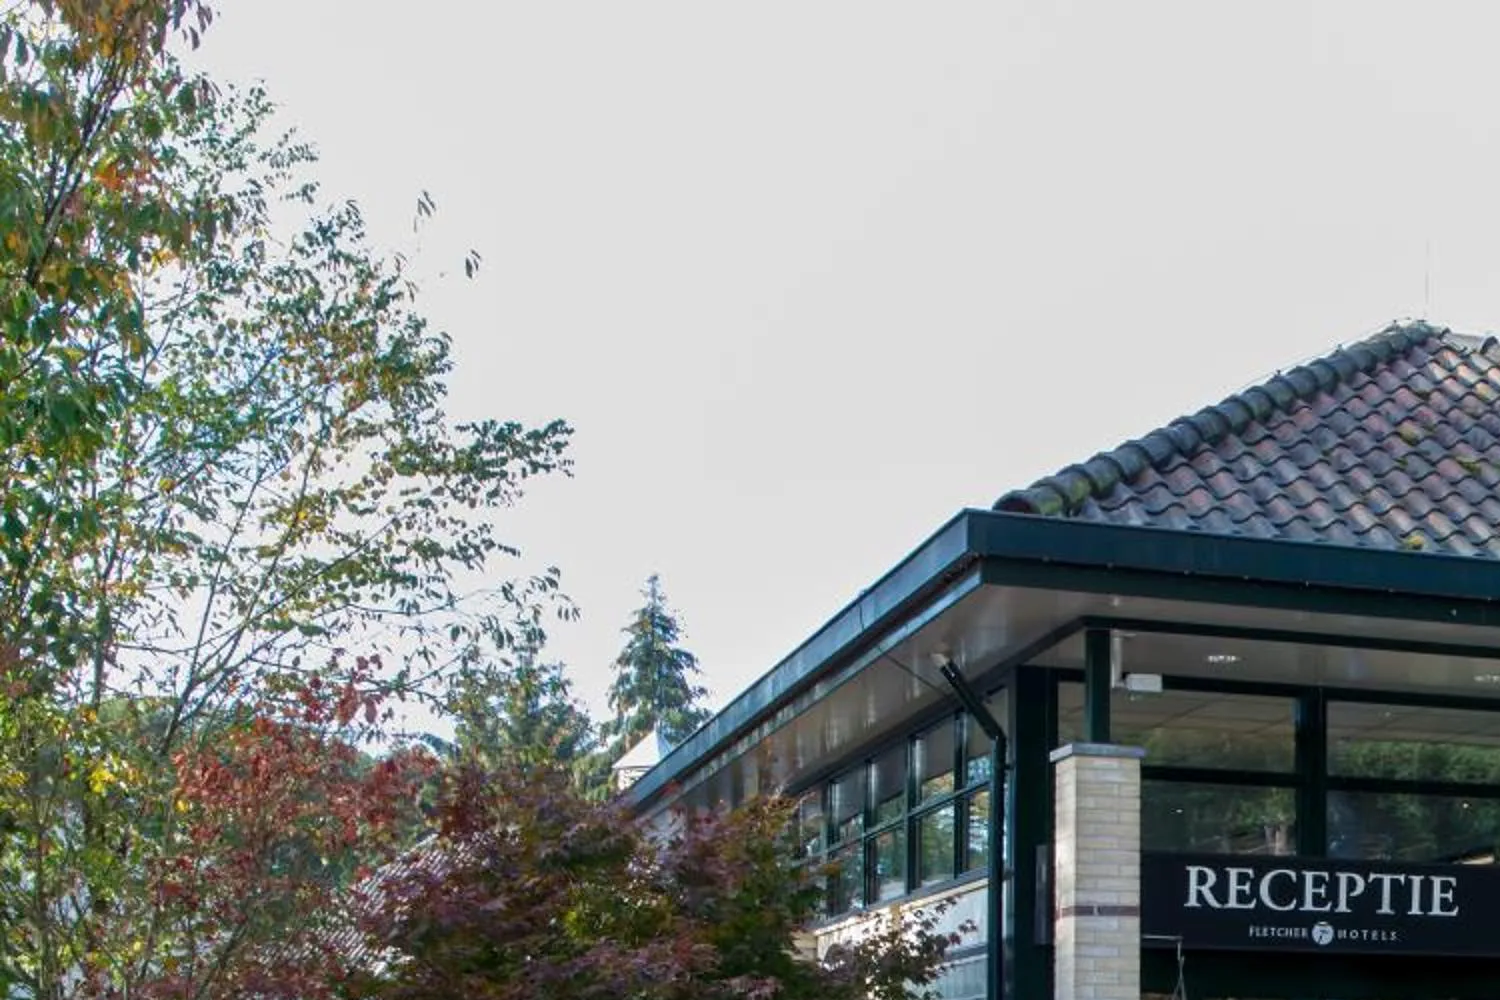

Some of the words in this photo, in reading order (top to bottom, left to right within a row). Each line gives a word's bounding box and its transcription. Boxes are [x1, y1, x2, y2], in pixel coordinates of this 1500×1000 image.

[1183, 865, 1460, 917] RECEPTIE
[1248, 925, 1310, 939] FLETCHER
[1337, 928, 1399, 942] HOTELS
